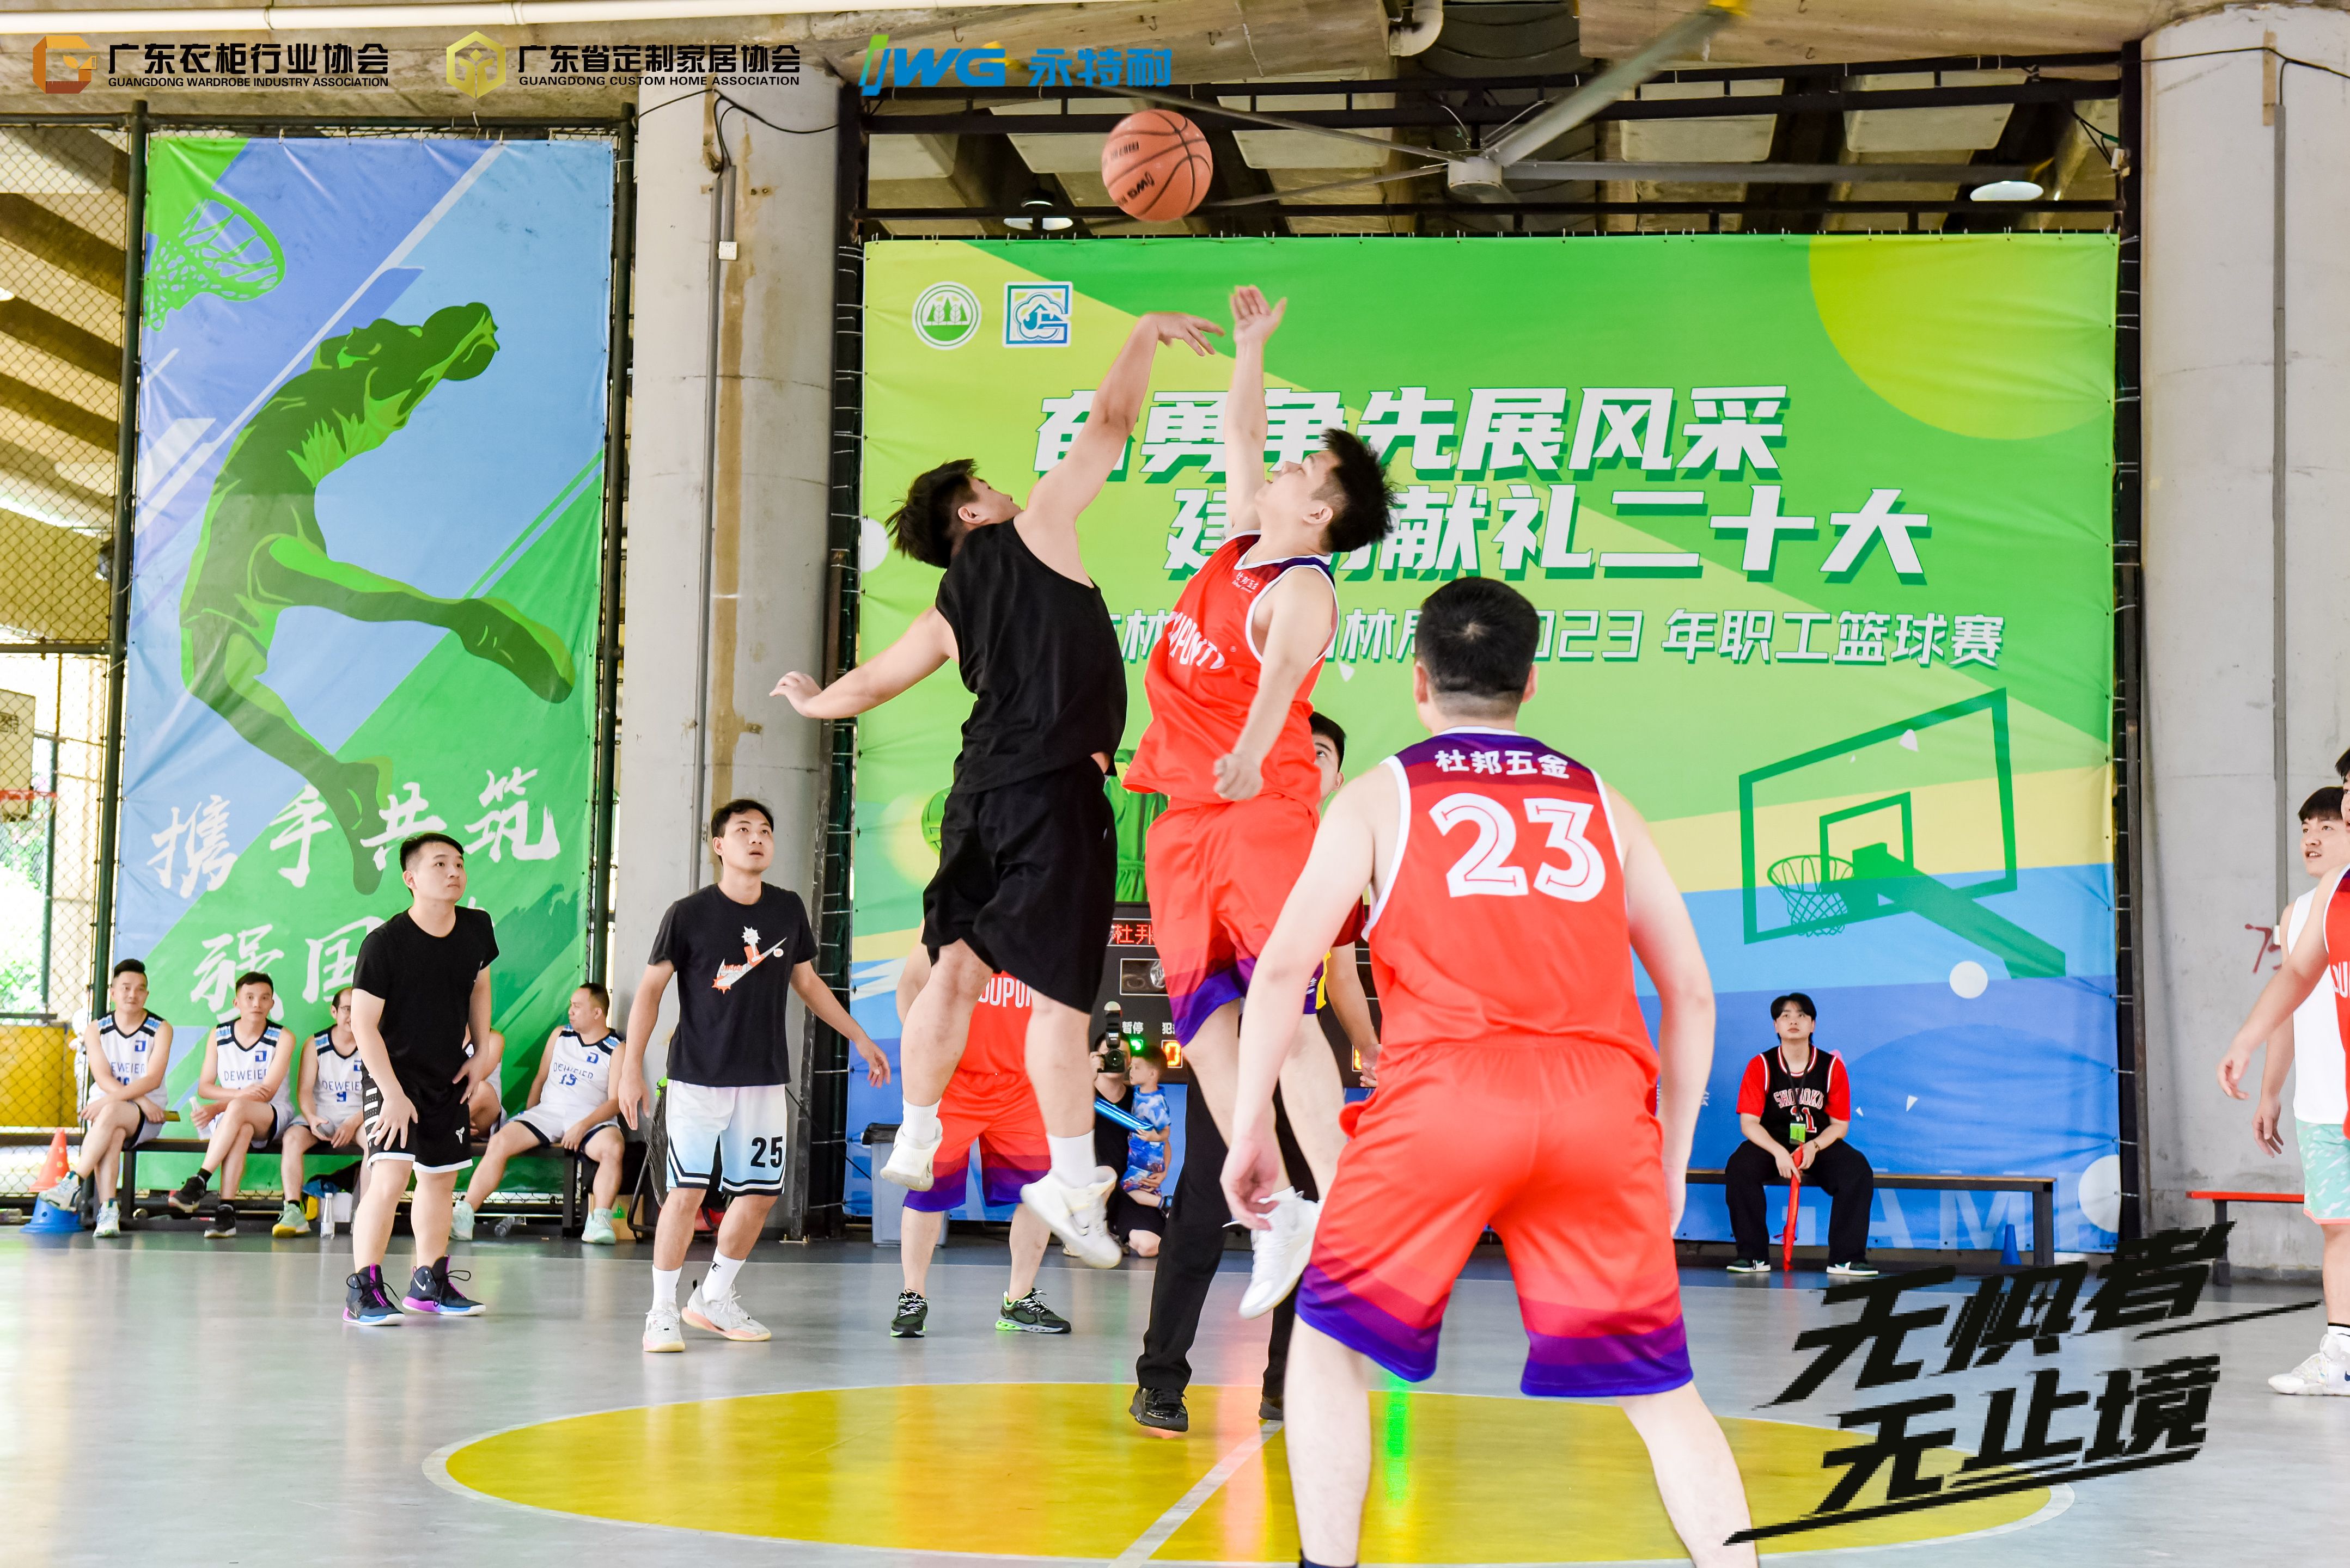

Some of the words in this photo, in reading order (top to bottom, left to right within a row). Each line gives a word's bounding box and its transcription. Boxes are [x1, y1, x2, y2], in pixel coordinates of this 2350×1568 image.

[1164, 484, 1931, 577] 建献礼二十大
[1661, 609, 2005, 667] 年职工篮球赛
[1435, 749, 1570, 779] 杜邦五金
[1429, 792, 1606, 902] 23
[1162, 1022, 1175, 1034] 犯
[559, 1074, 577, 1086] 15
[336, 1092, 347, 1102] 9
[750, 1137, 783, 1168] 25
